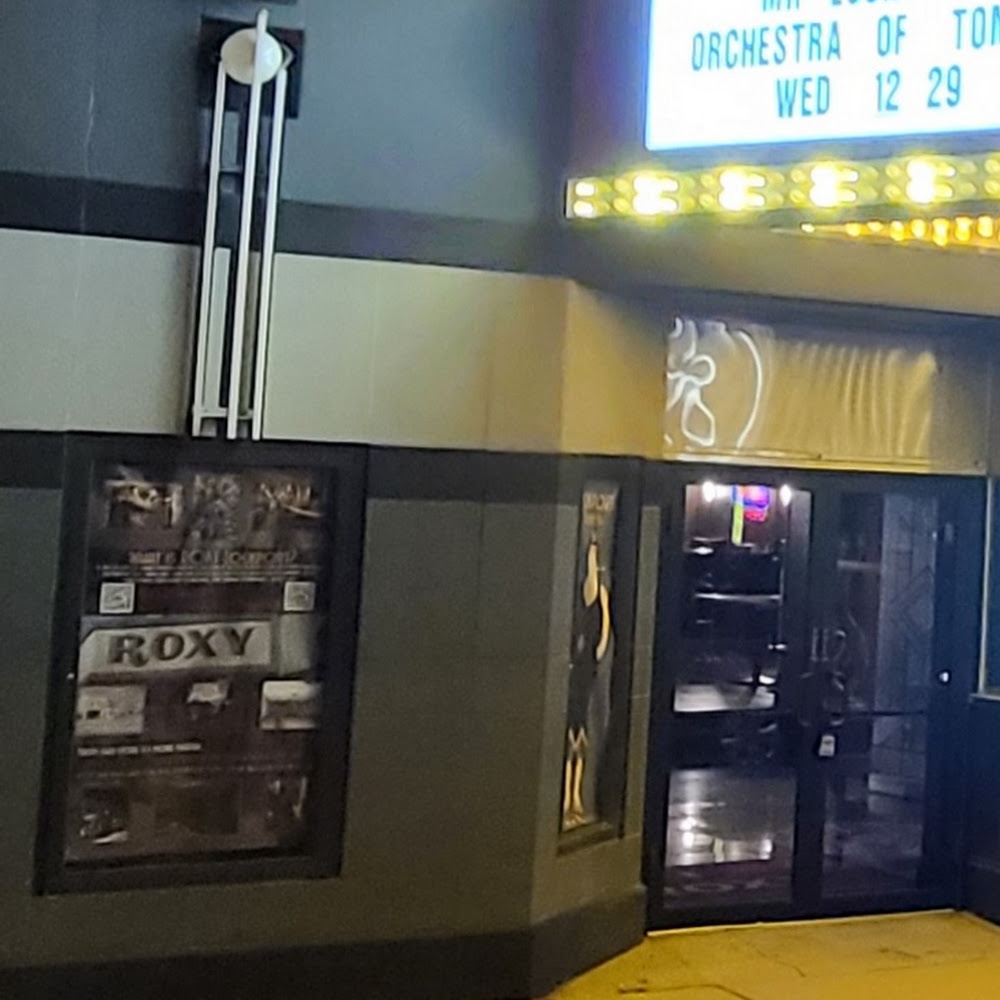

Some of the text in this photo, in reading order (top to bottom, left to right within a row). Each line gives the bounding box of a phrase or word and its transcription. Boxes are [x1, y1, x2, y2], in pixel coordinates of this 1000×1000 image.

[691, 20, 841, 72] ORCHESTRA
[877, 14, 907, 57] OF
[775, 75, 831, 118] WED
[875, 70, 901, 112] 12
[927, 64, 962, 109] 29
[108, 626, 254, 668] ROXY
